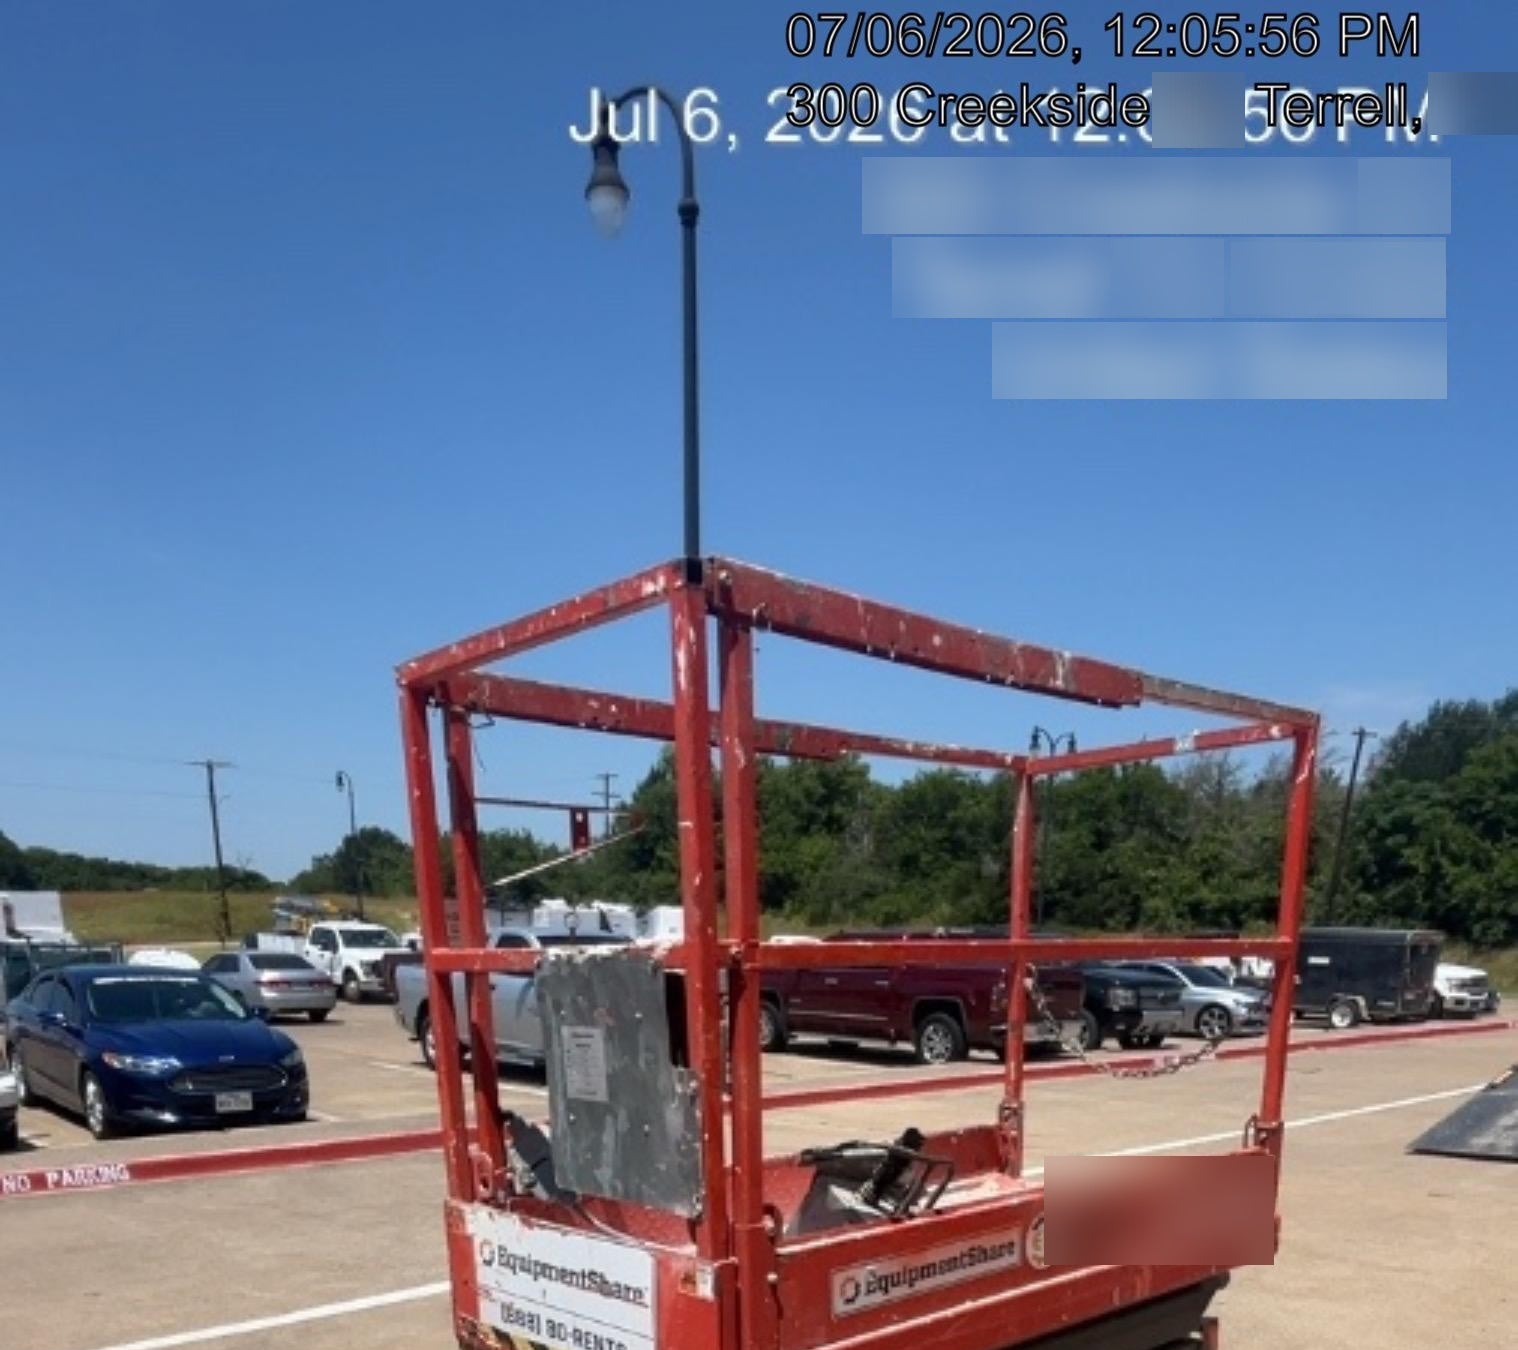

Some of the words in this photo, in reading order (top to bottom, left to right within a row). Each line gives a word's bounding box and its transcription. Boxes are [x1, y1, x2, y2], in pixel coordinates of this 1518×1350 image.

[2, 1174, 32, 1194] NO
[46, 1163, 130, 1190] PARKING
[497, 1244, 648, 1305] EquipmentShare
[864, 1239, 1015, 1297] EquipmentShare
